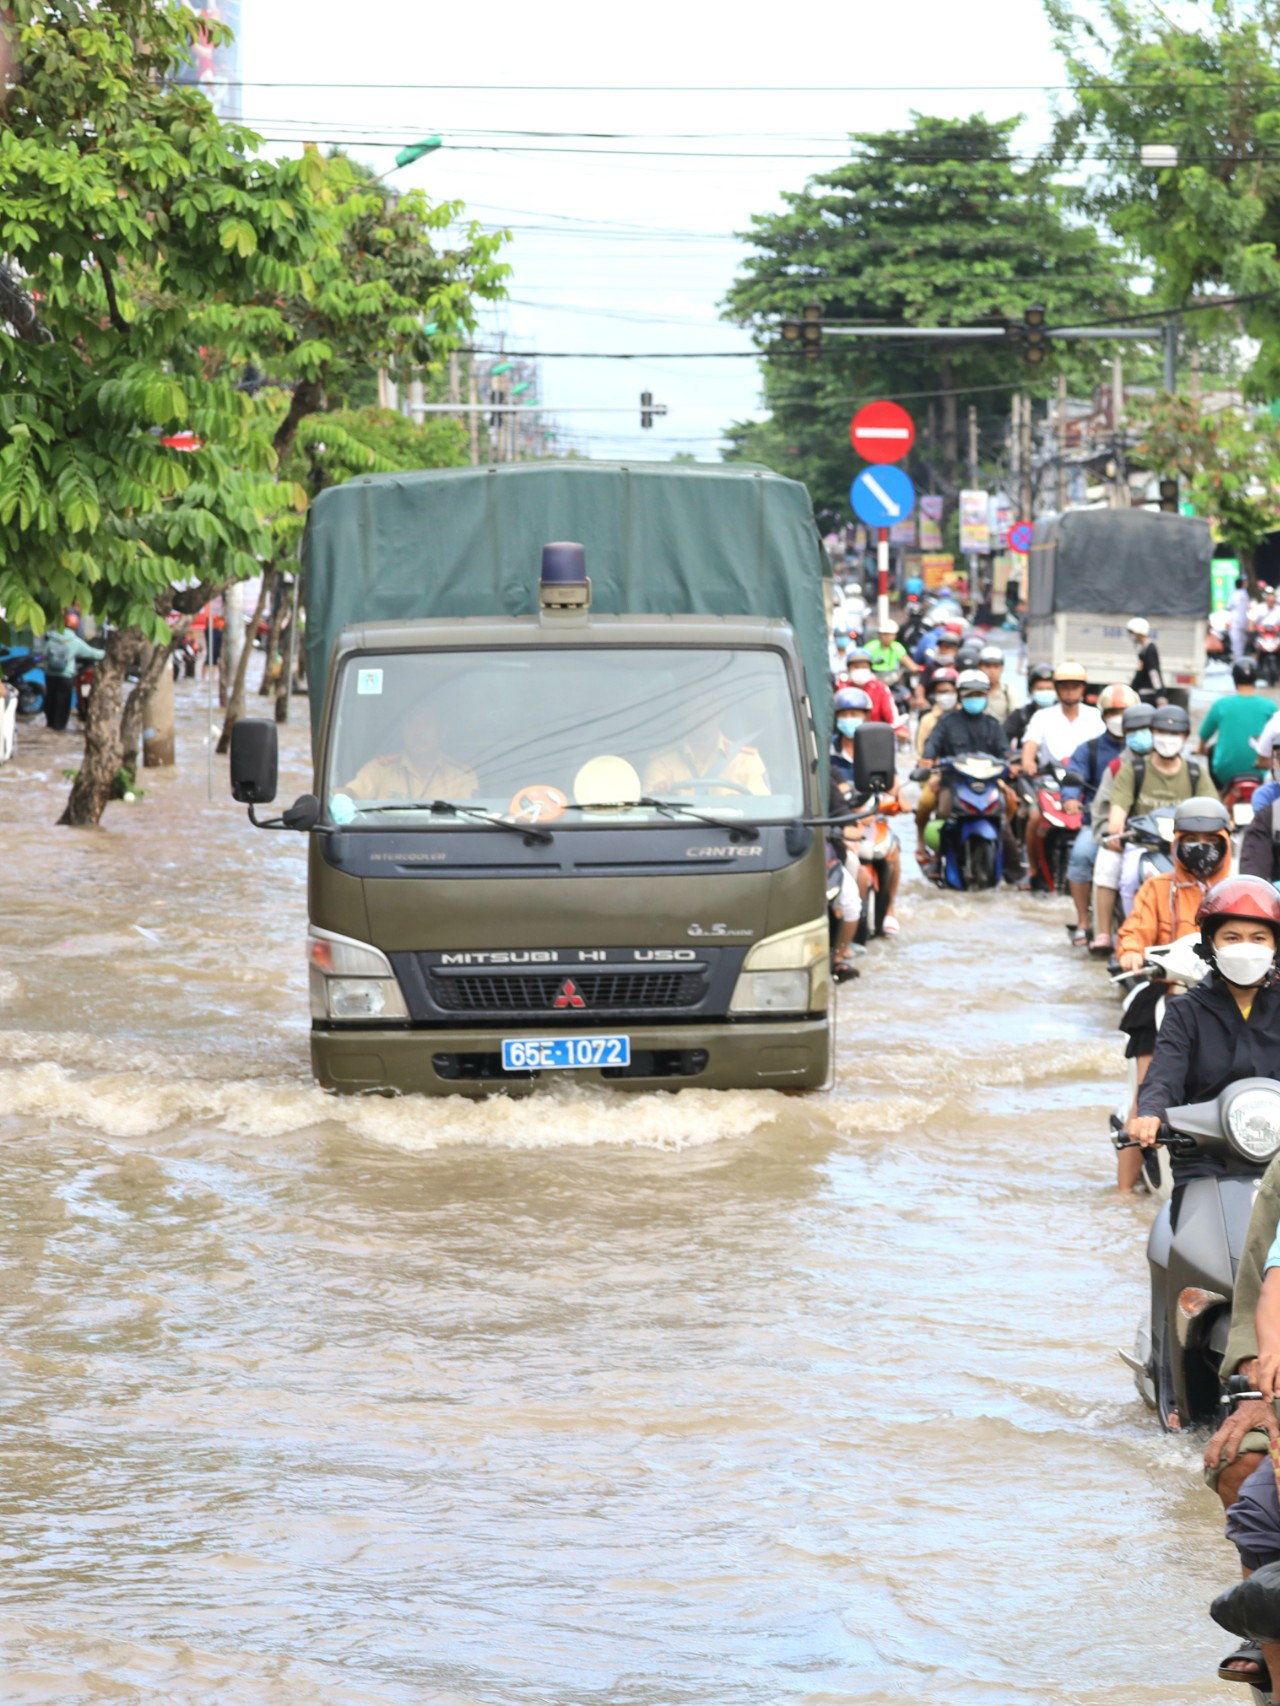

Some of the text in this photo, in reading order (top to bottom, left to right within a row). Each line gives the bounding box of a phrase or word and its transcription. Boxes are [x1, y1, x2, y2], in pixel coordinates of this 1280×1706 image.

[686, 846, 763, 857] CANTER
[441, 950, 696, 964] MITSUBI HI USO
[510, 1039, 622, 1066] 65E-1072
